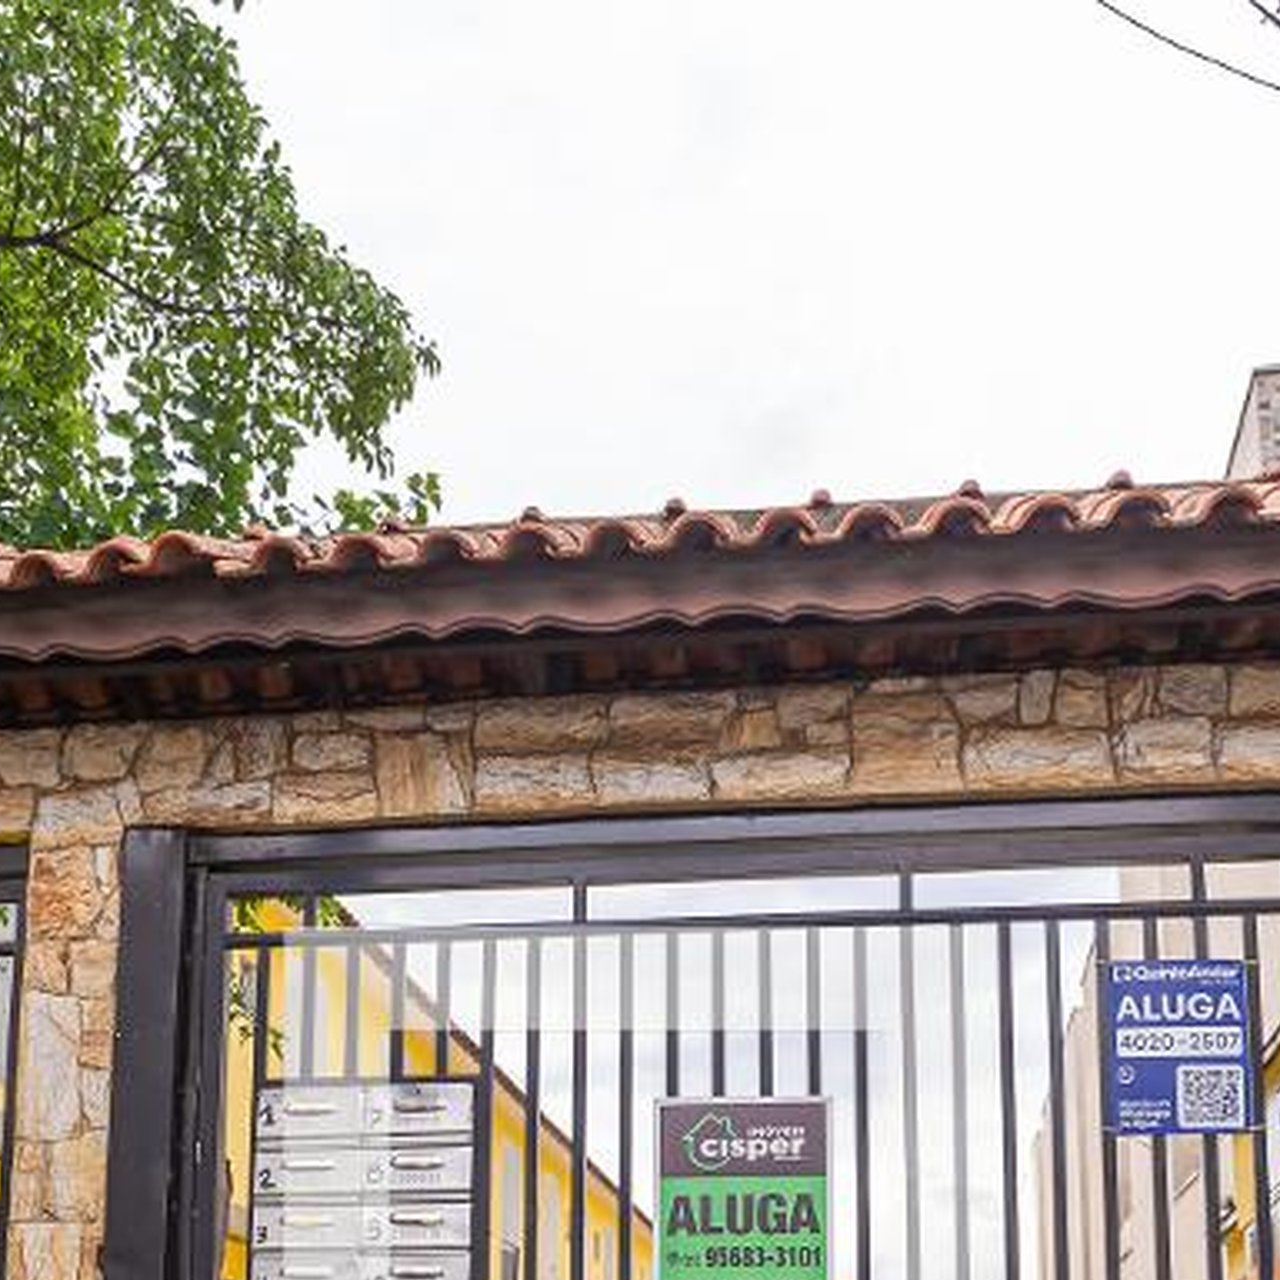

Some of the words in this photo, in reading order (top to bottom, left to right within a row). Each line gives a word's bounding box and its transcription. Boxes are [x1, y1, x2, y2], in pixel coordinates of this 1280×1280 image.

[1116, 992, 1241, 1022] ALUGA
[1120, 1032, 1239, 1051] 4020-2507
[699, 1137, 806, 1161] cisper
[258, 1168, 276, 1190] 2
[667, 1192, 821, 1236] ALUGA
[256, 1225, 268, 1244] 3
